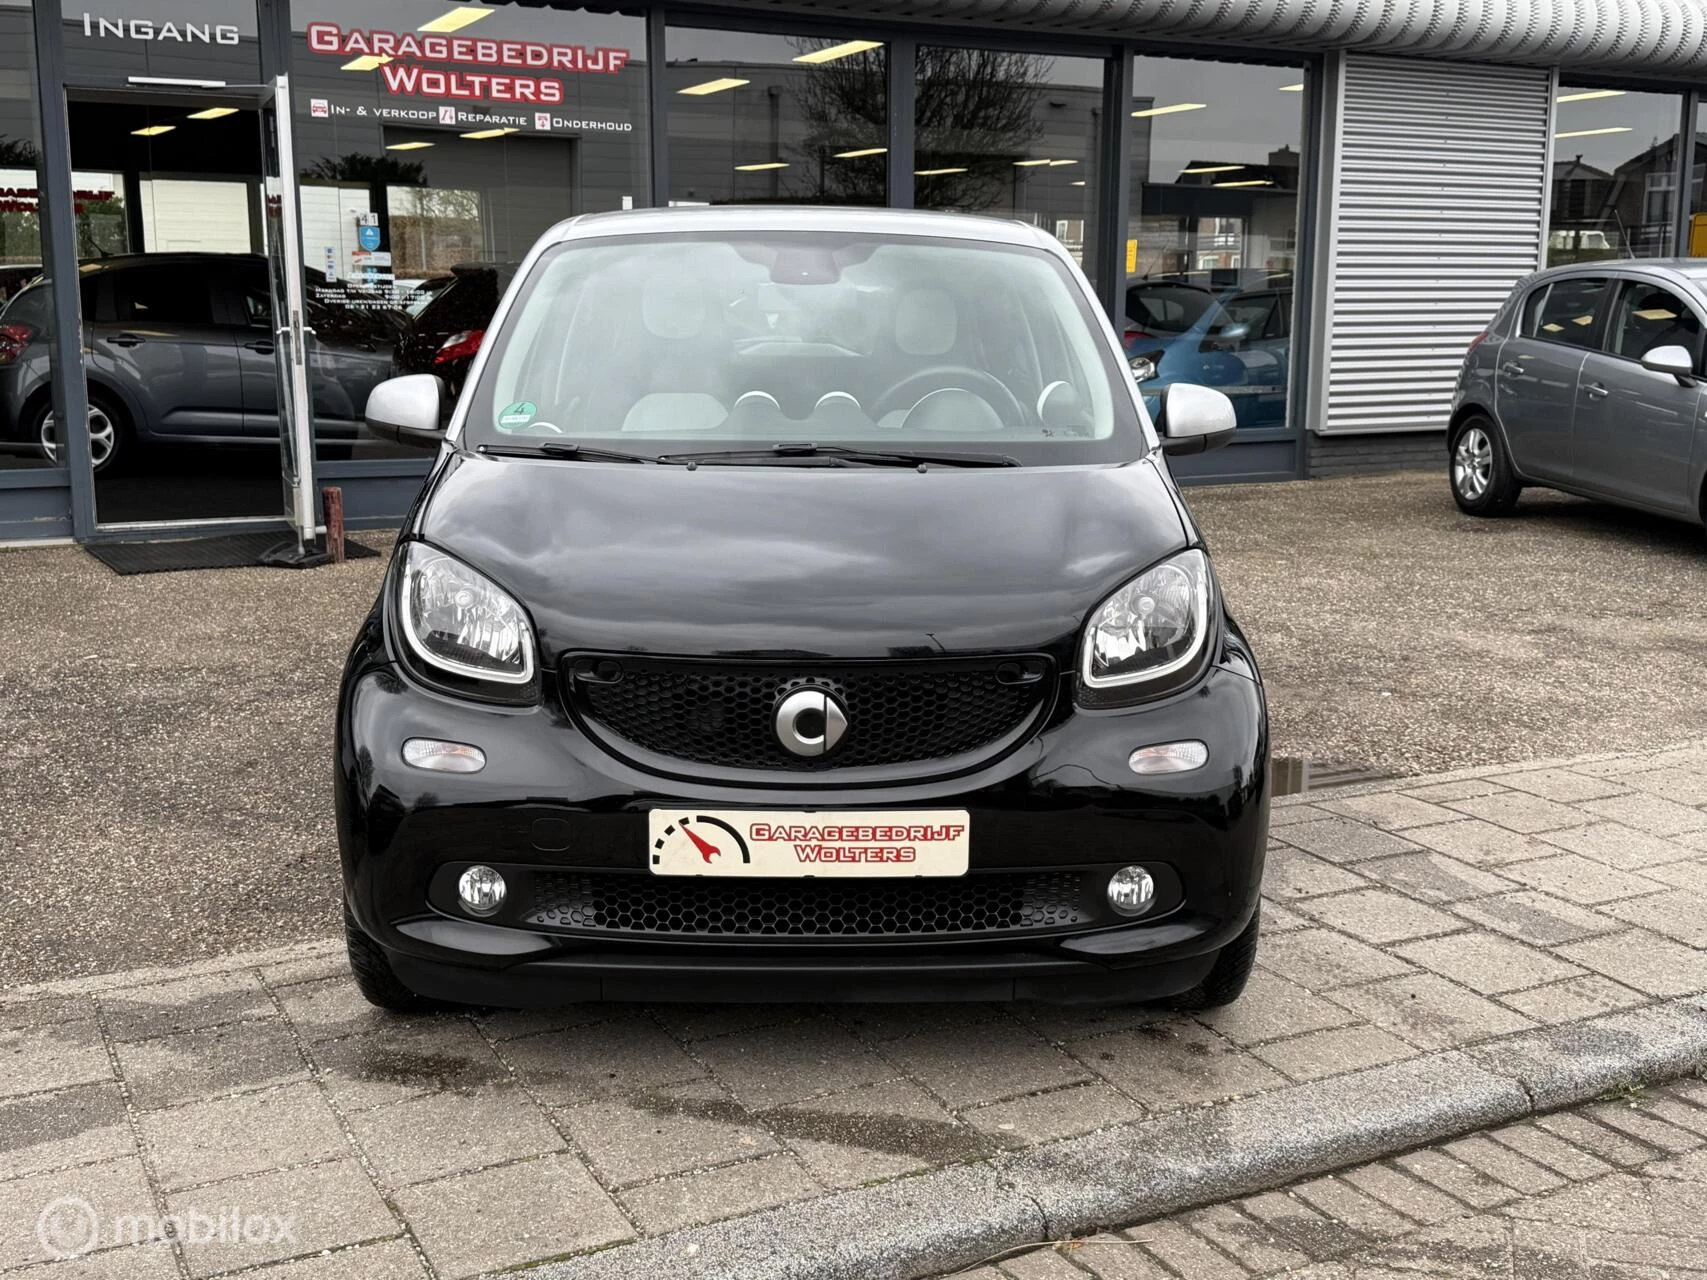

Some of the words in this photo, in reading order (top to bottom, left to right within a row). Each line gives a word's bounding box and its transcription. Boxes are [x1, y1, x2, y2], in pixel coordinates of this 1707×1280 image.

[83, 12, 240, 45] INGANG
[307, 22, 630, 74] GARAGEBEDRIJF
[381, 63, 565, 105] WOLTERS
[331, 104, 351, 115] IN-
[356, 106, 368, 116] &
[373, 108, 437, 120] VERKOOP
[458, 111, 528, 126] REPARATIE
[552, 117, 633, 132] ONDERHOUD
[513, 402, 525, 415] 4
[750, 823, 965, 842] GARAGEBEDRIJF
[794, 844, 916, 863] WOLTERS
